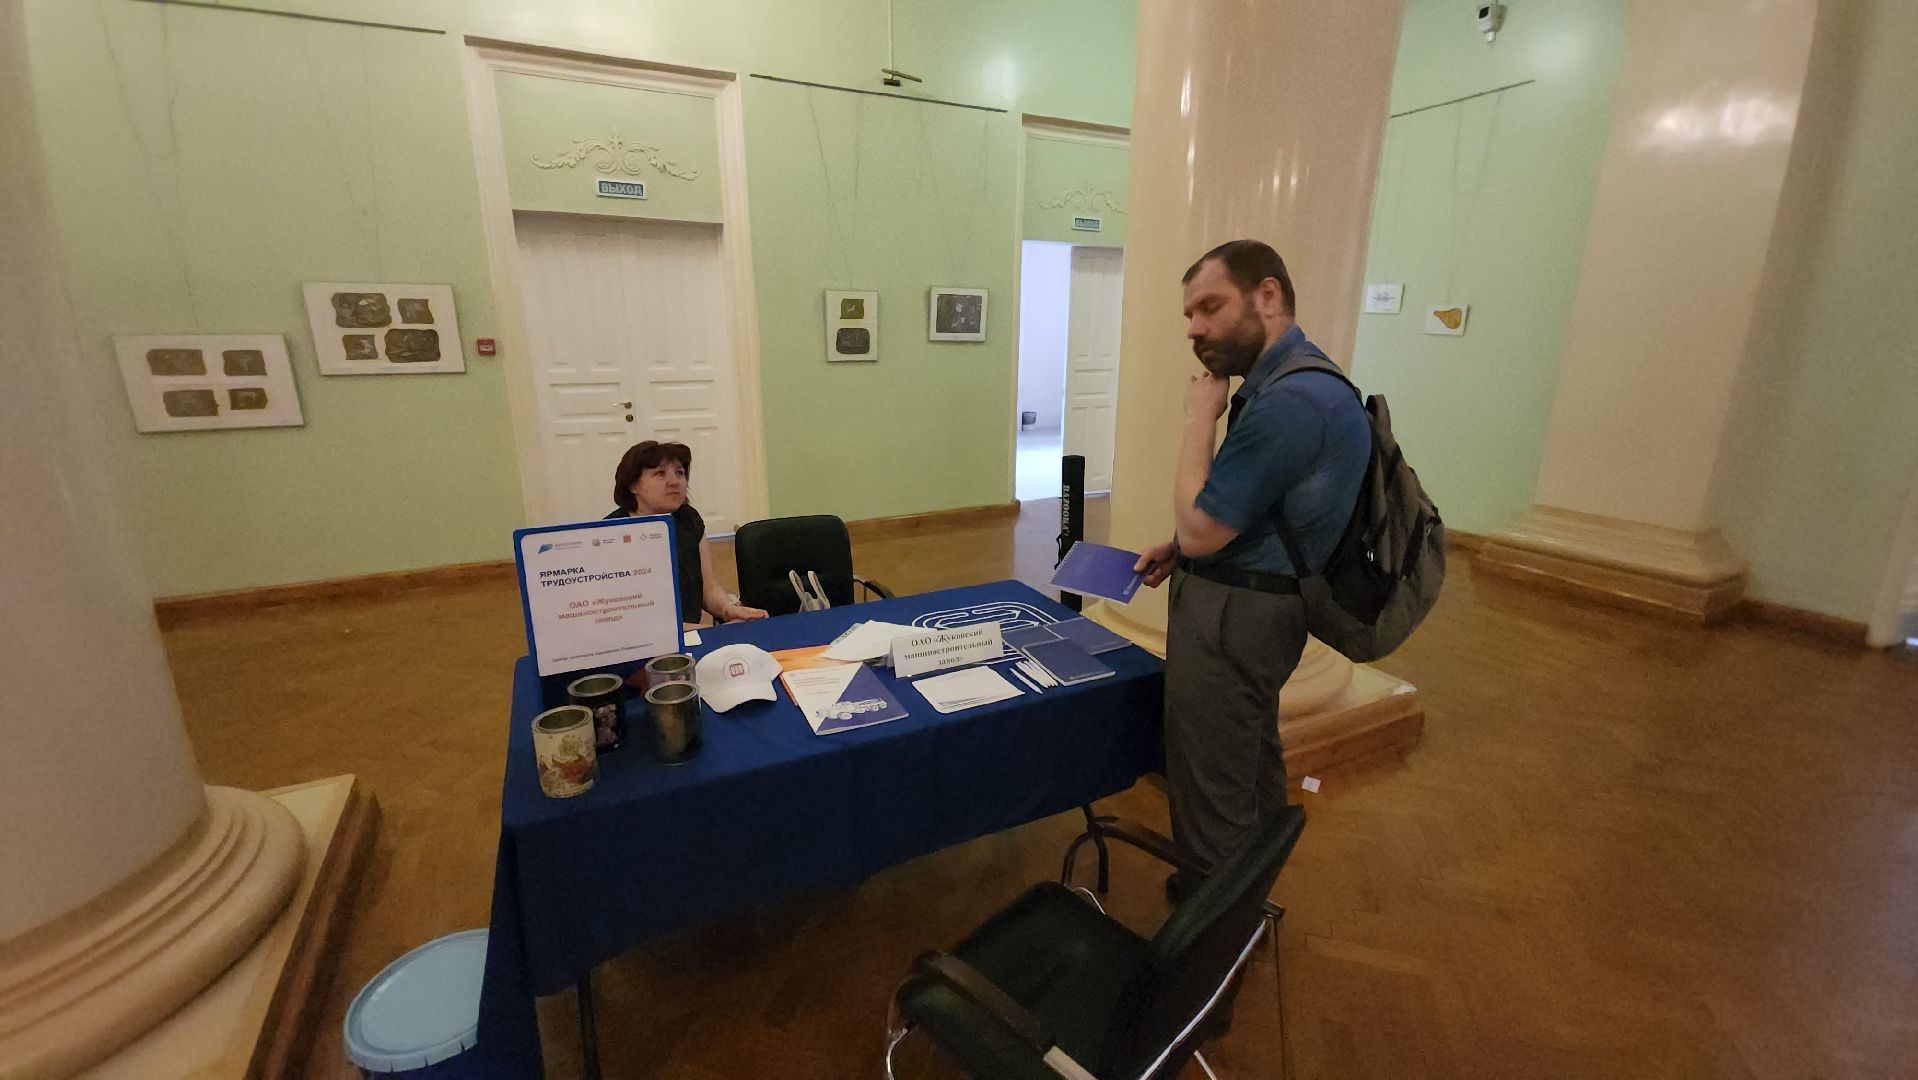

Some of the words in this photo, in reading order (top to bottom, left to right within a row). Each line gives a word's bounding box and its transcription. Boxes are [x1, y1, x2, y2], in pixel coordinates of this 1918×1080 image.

[601, 182, 643, 196] ВЫХОД
[539, 566, 585, 578] ЯРМАРКА
[541, 570, 632, 587] ТРУДОУСТРОЙСТВА
[633, 567, 652, 576] 2024
[569, 601, 589, 609] ОАО
[911, 636, 932, 648] ОАО
